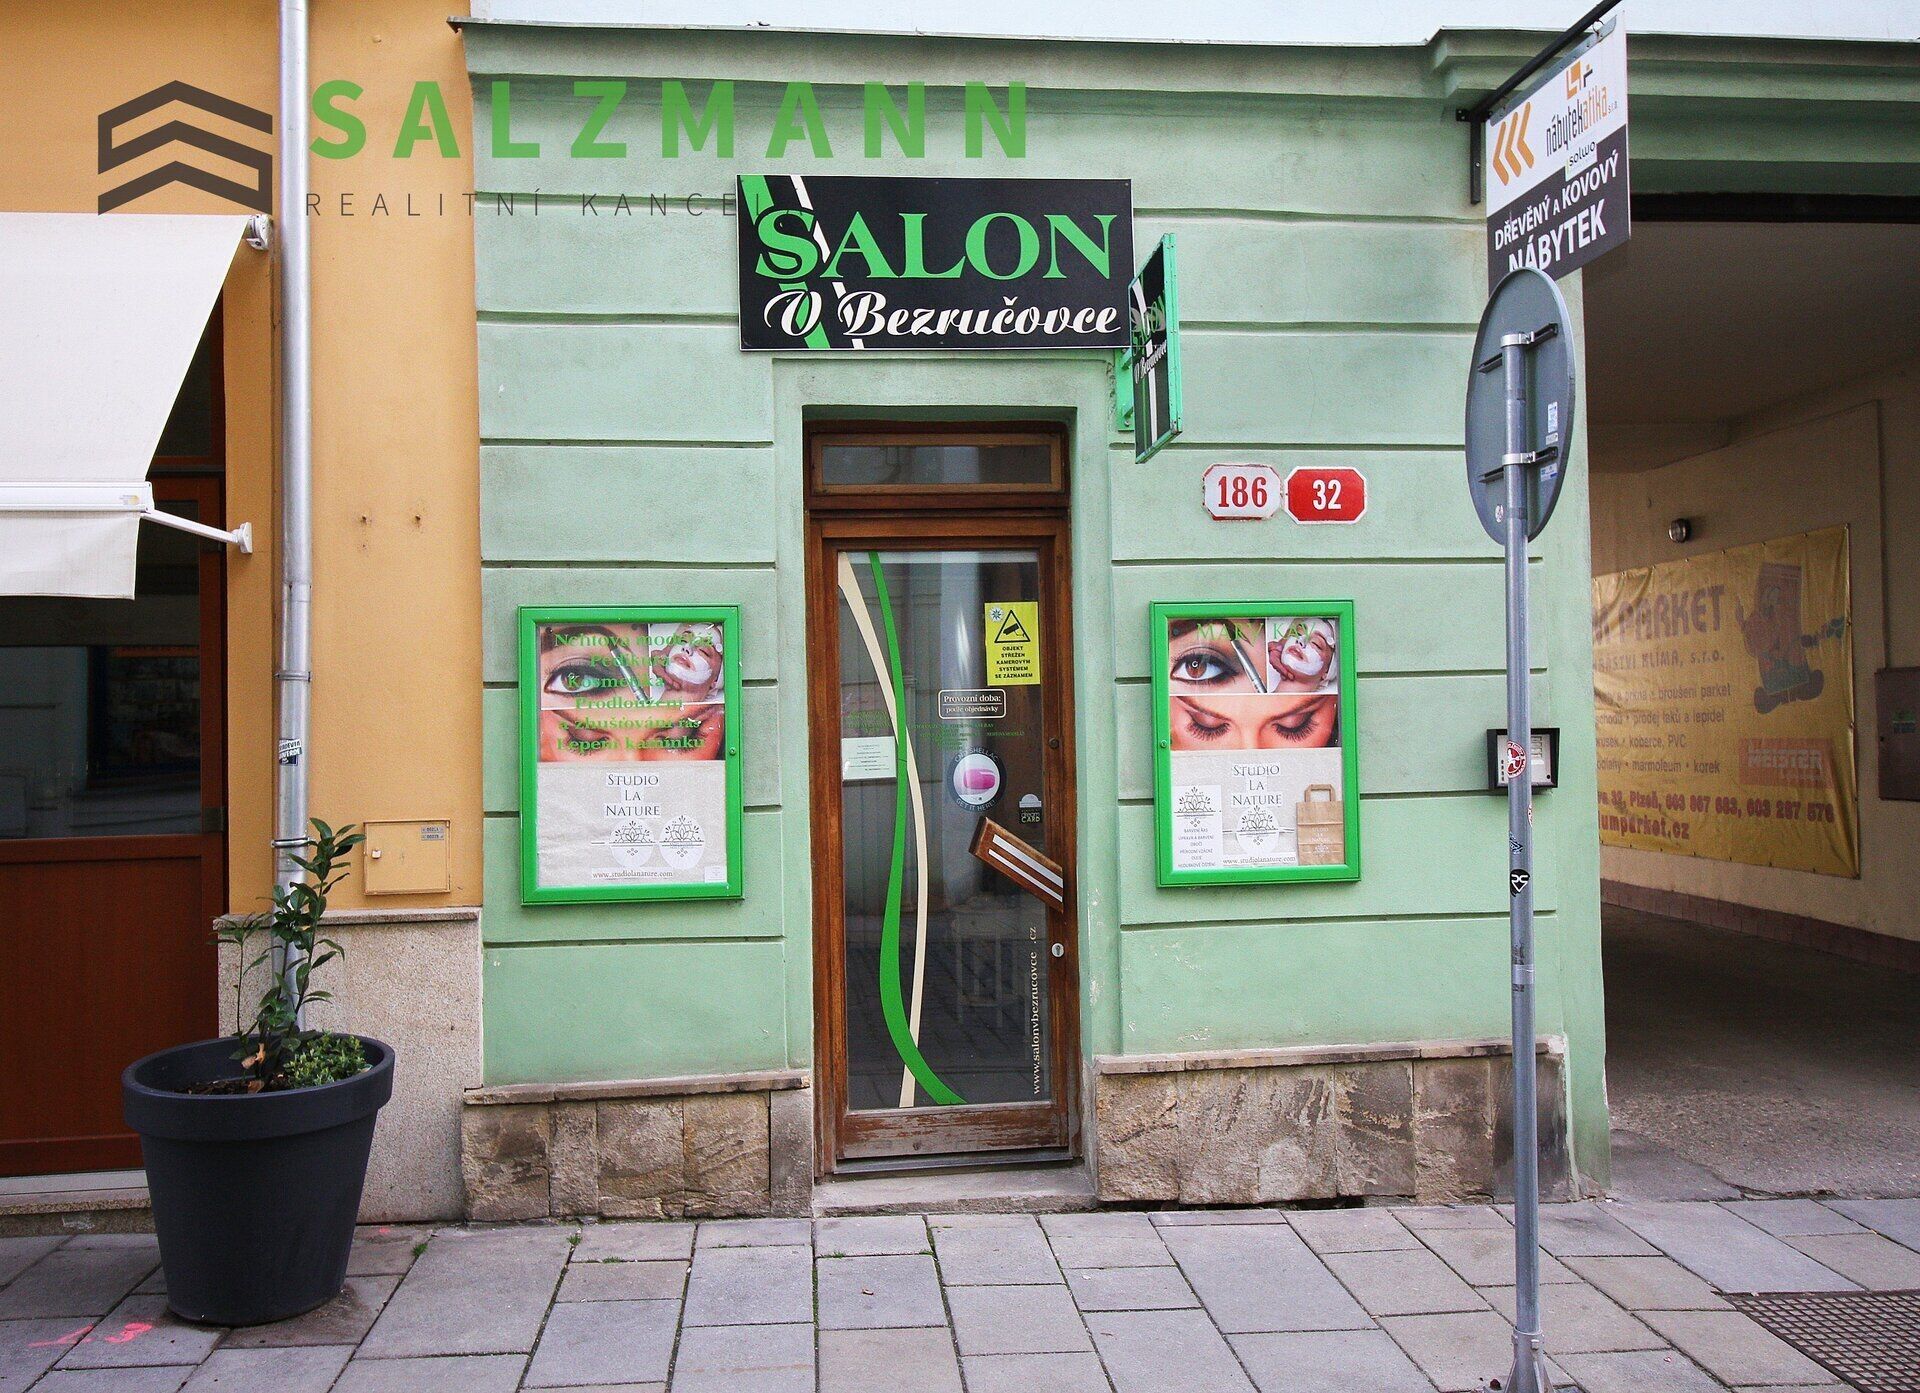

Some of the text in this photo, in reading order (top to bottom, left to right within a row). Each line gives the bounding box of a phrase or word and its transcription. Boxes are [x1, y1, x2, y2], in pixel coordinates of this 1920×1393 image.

[1494, 149, 1619, 251] DŘEVĚNÝ A KOVOVÝ
[755, 209, 1118, 280] SALON
[1508, 198, 1607, 273] NÁBYTEK
[837, 290, 1122, 337] Bezručovce
[1218, 476, 1268, 508] 186
[1312, 479, 1342, 511] 32
[1619, 584, 1725, 643] PARKET
[1196, 622, 1316, 642] MARY KAY
[943, 693, 1001, 703] Provozní doba:
[946, 705, 999, 714] podle objednávky
[969, 746, 1000, 762] SHELLAC
[1233, 764, 1280, 776] STUDIO
[1694, 759, 1721, 774] korek
[607, 773, 659, 786] STUDIO
[606, 804, 660, 817] NATURE
[1232, 795, 1281, 806] NATURE
[1029, 951, 1041, 1095] www.salonvbezrucovce
